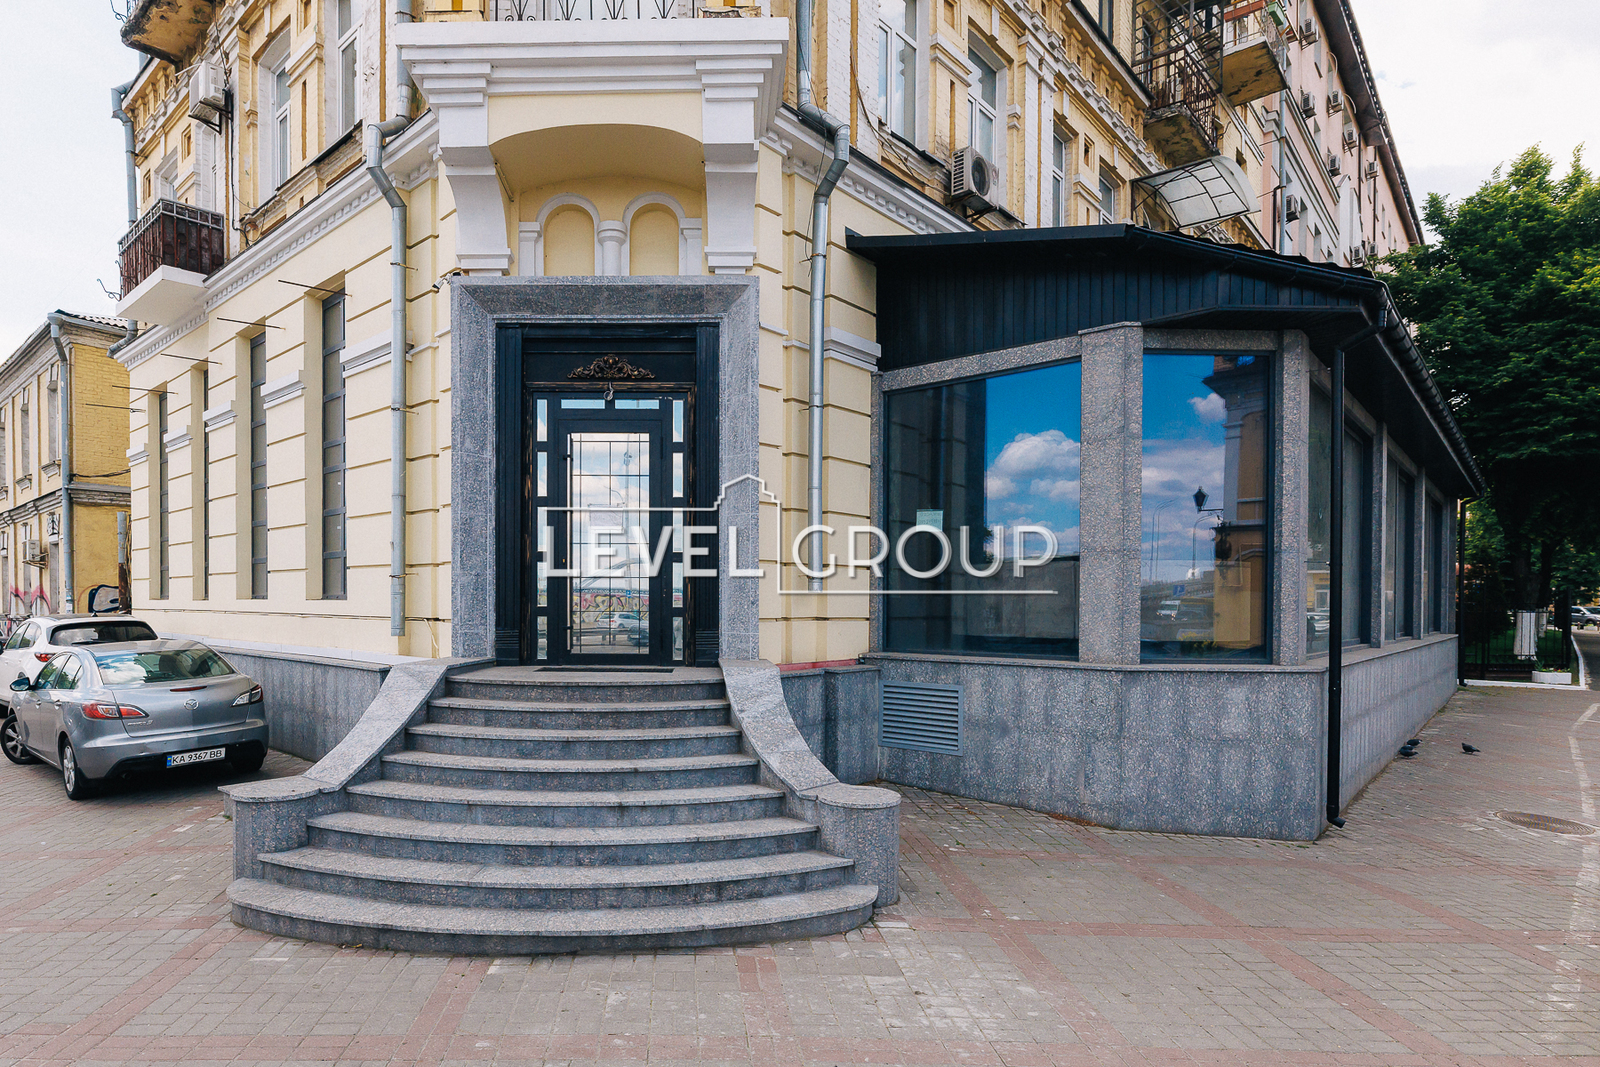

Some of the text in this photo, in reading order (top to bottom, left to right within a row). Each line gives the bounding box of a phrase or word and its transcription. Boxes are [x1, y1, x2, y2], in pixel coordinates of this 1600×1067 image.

[172, 755, 186, 764] KA
[187, 752, 208, 762] 9367
[209, 749, 222, 759] BB
